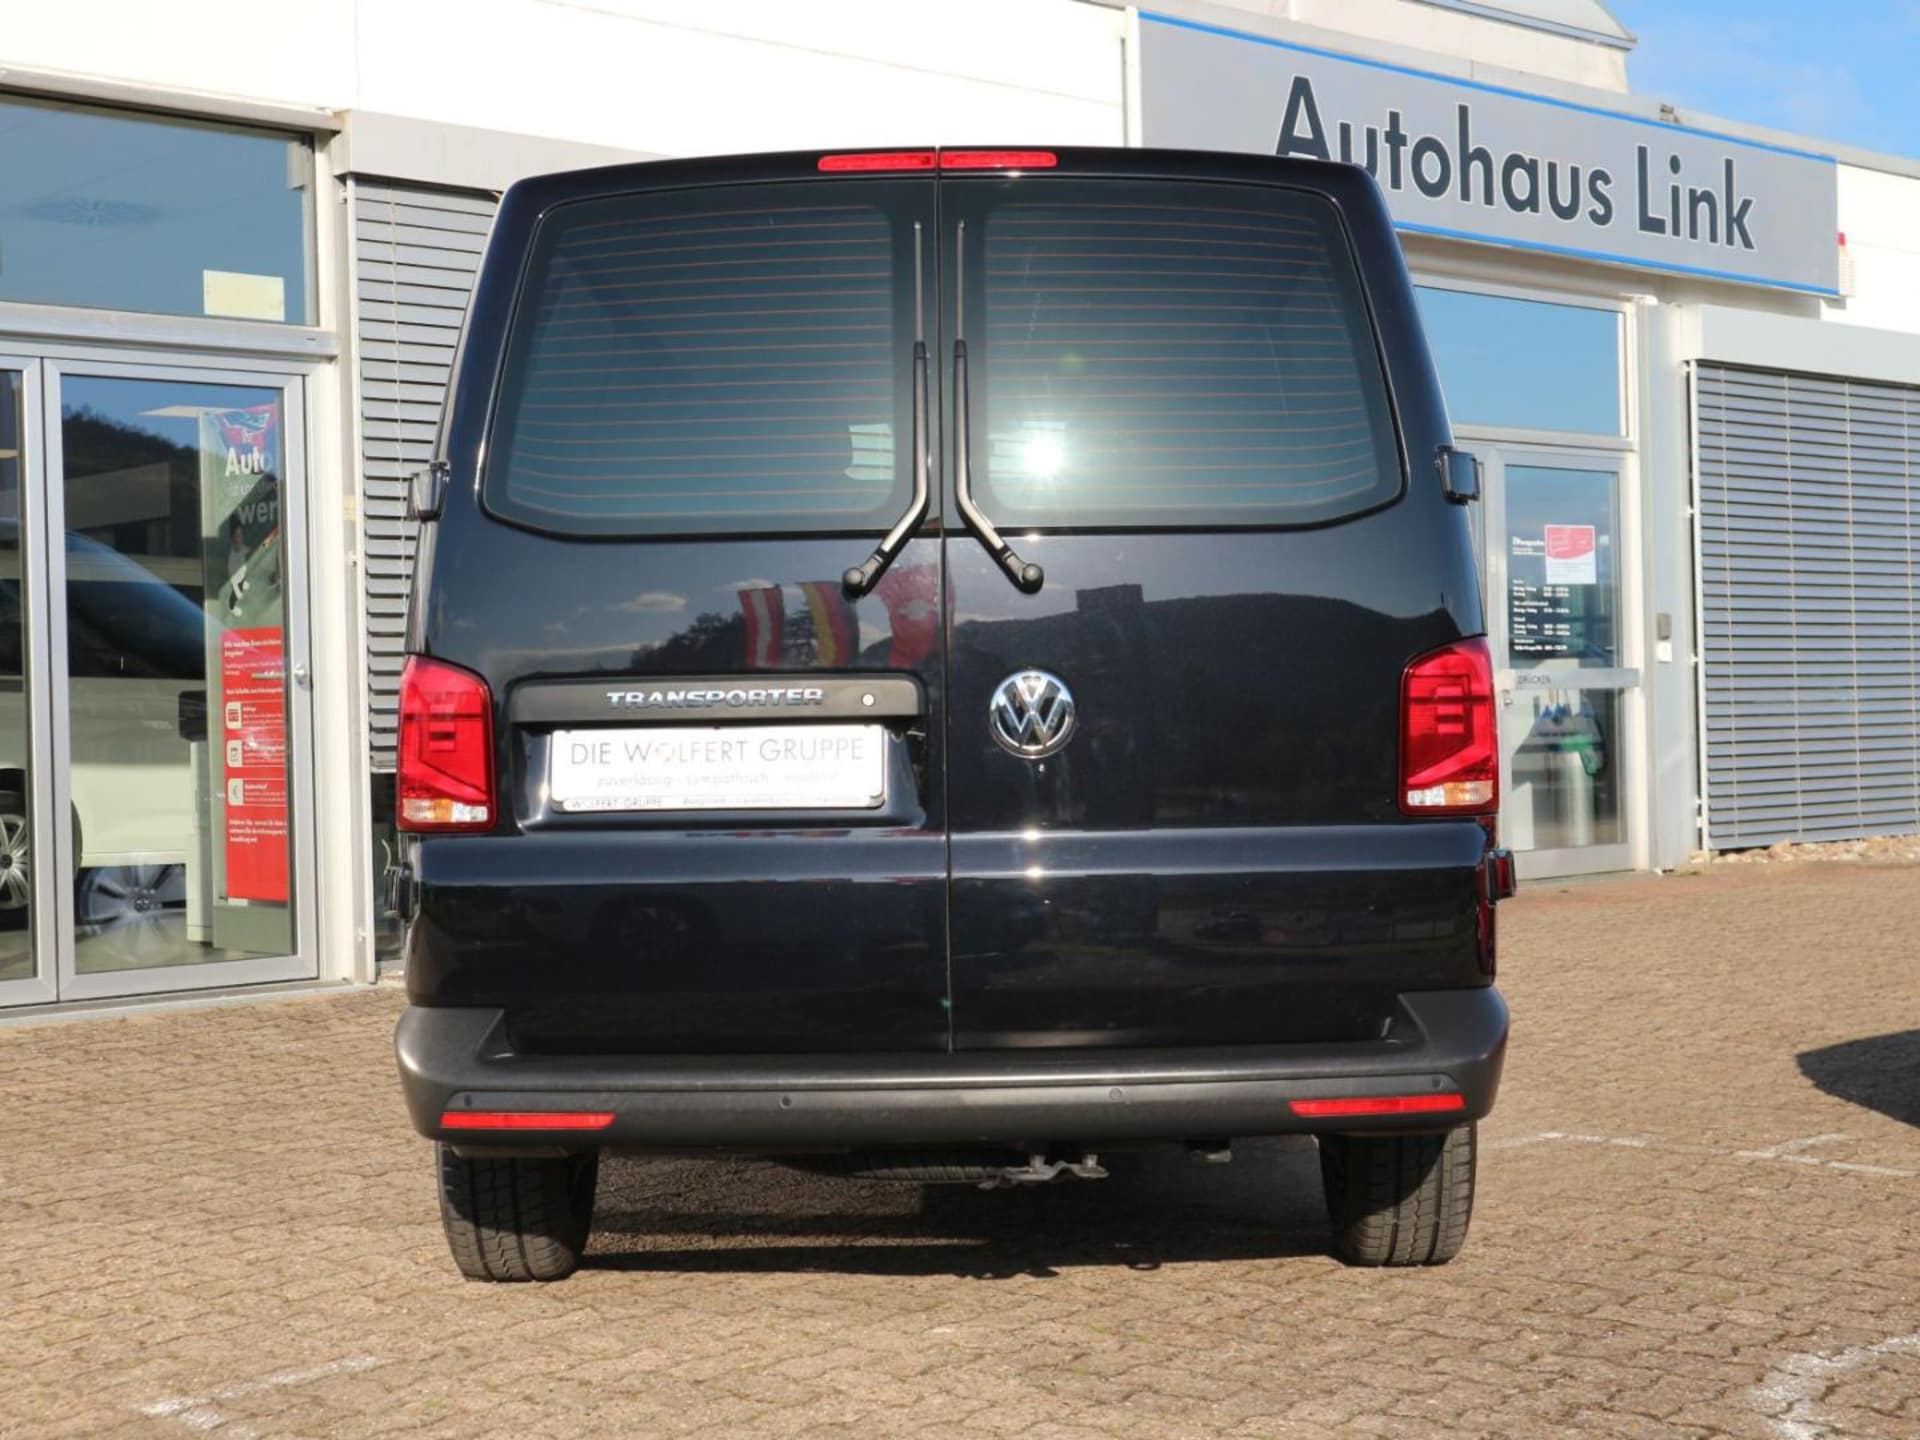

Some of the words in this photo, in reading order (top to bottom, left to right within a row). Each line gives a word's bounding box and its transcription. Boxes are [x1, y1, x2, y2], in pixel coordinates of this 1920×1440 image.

[1274, 75, 1615, 227] Autohaus
[1636, 144, 1757, 251] Link
[606, 687, 824, 709] TRANSPORTER
[570, 741, 612, 765] DIE
[624, 740, 749, 764] WOLFERT
[758, 737, 865, 763] GRUPPE
